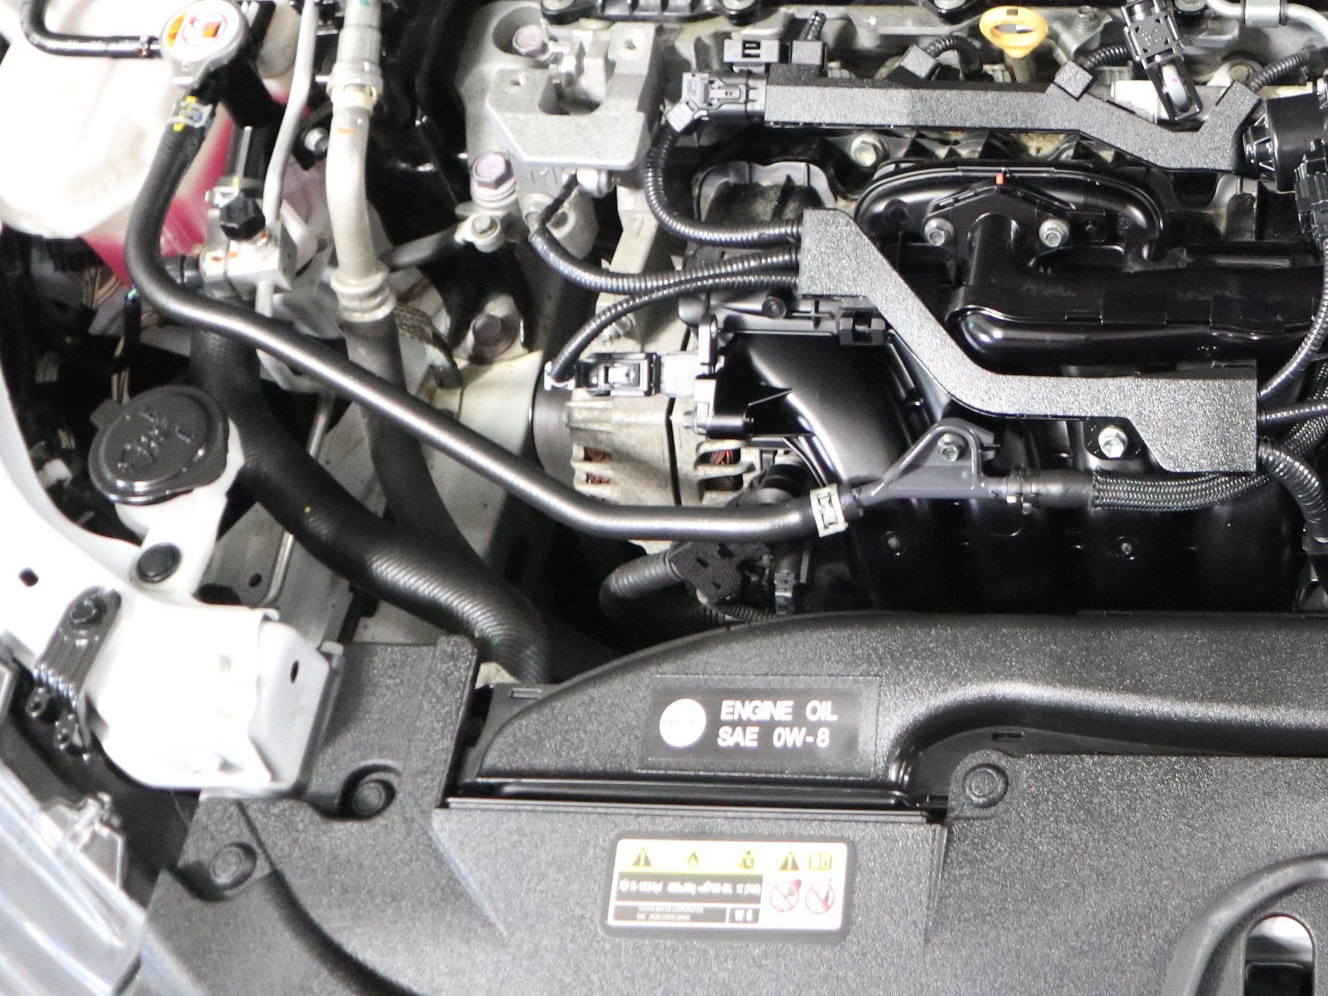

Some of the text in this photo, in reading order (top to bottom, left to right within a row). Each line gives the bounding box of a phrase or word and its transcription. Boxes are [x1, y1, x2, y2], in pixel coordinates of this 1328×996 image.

[720, 699, 838, 721] ENGINE OIL
[717, 725, 830, 748] SAE 0W-8
